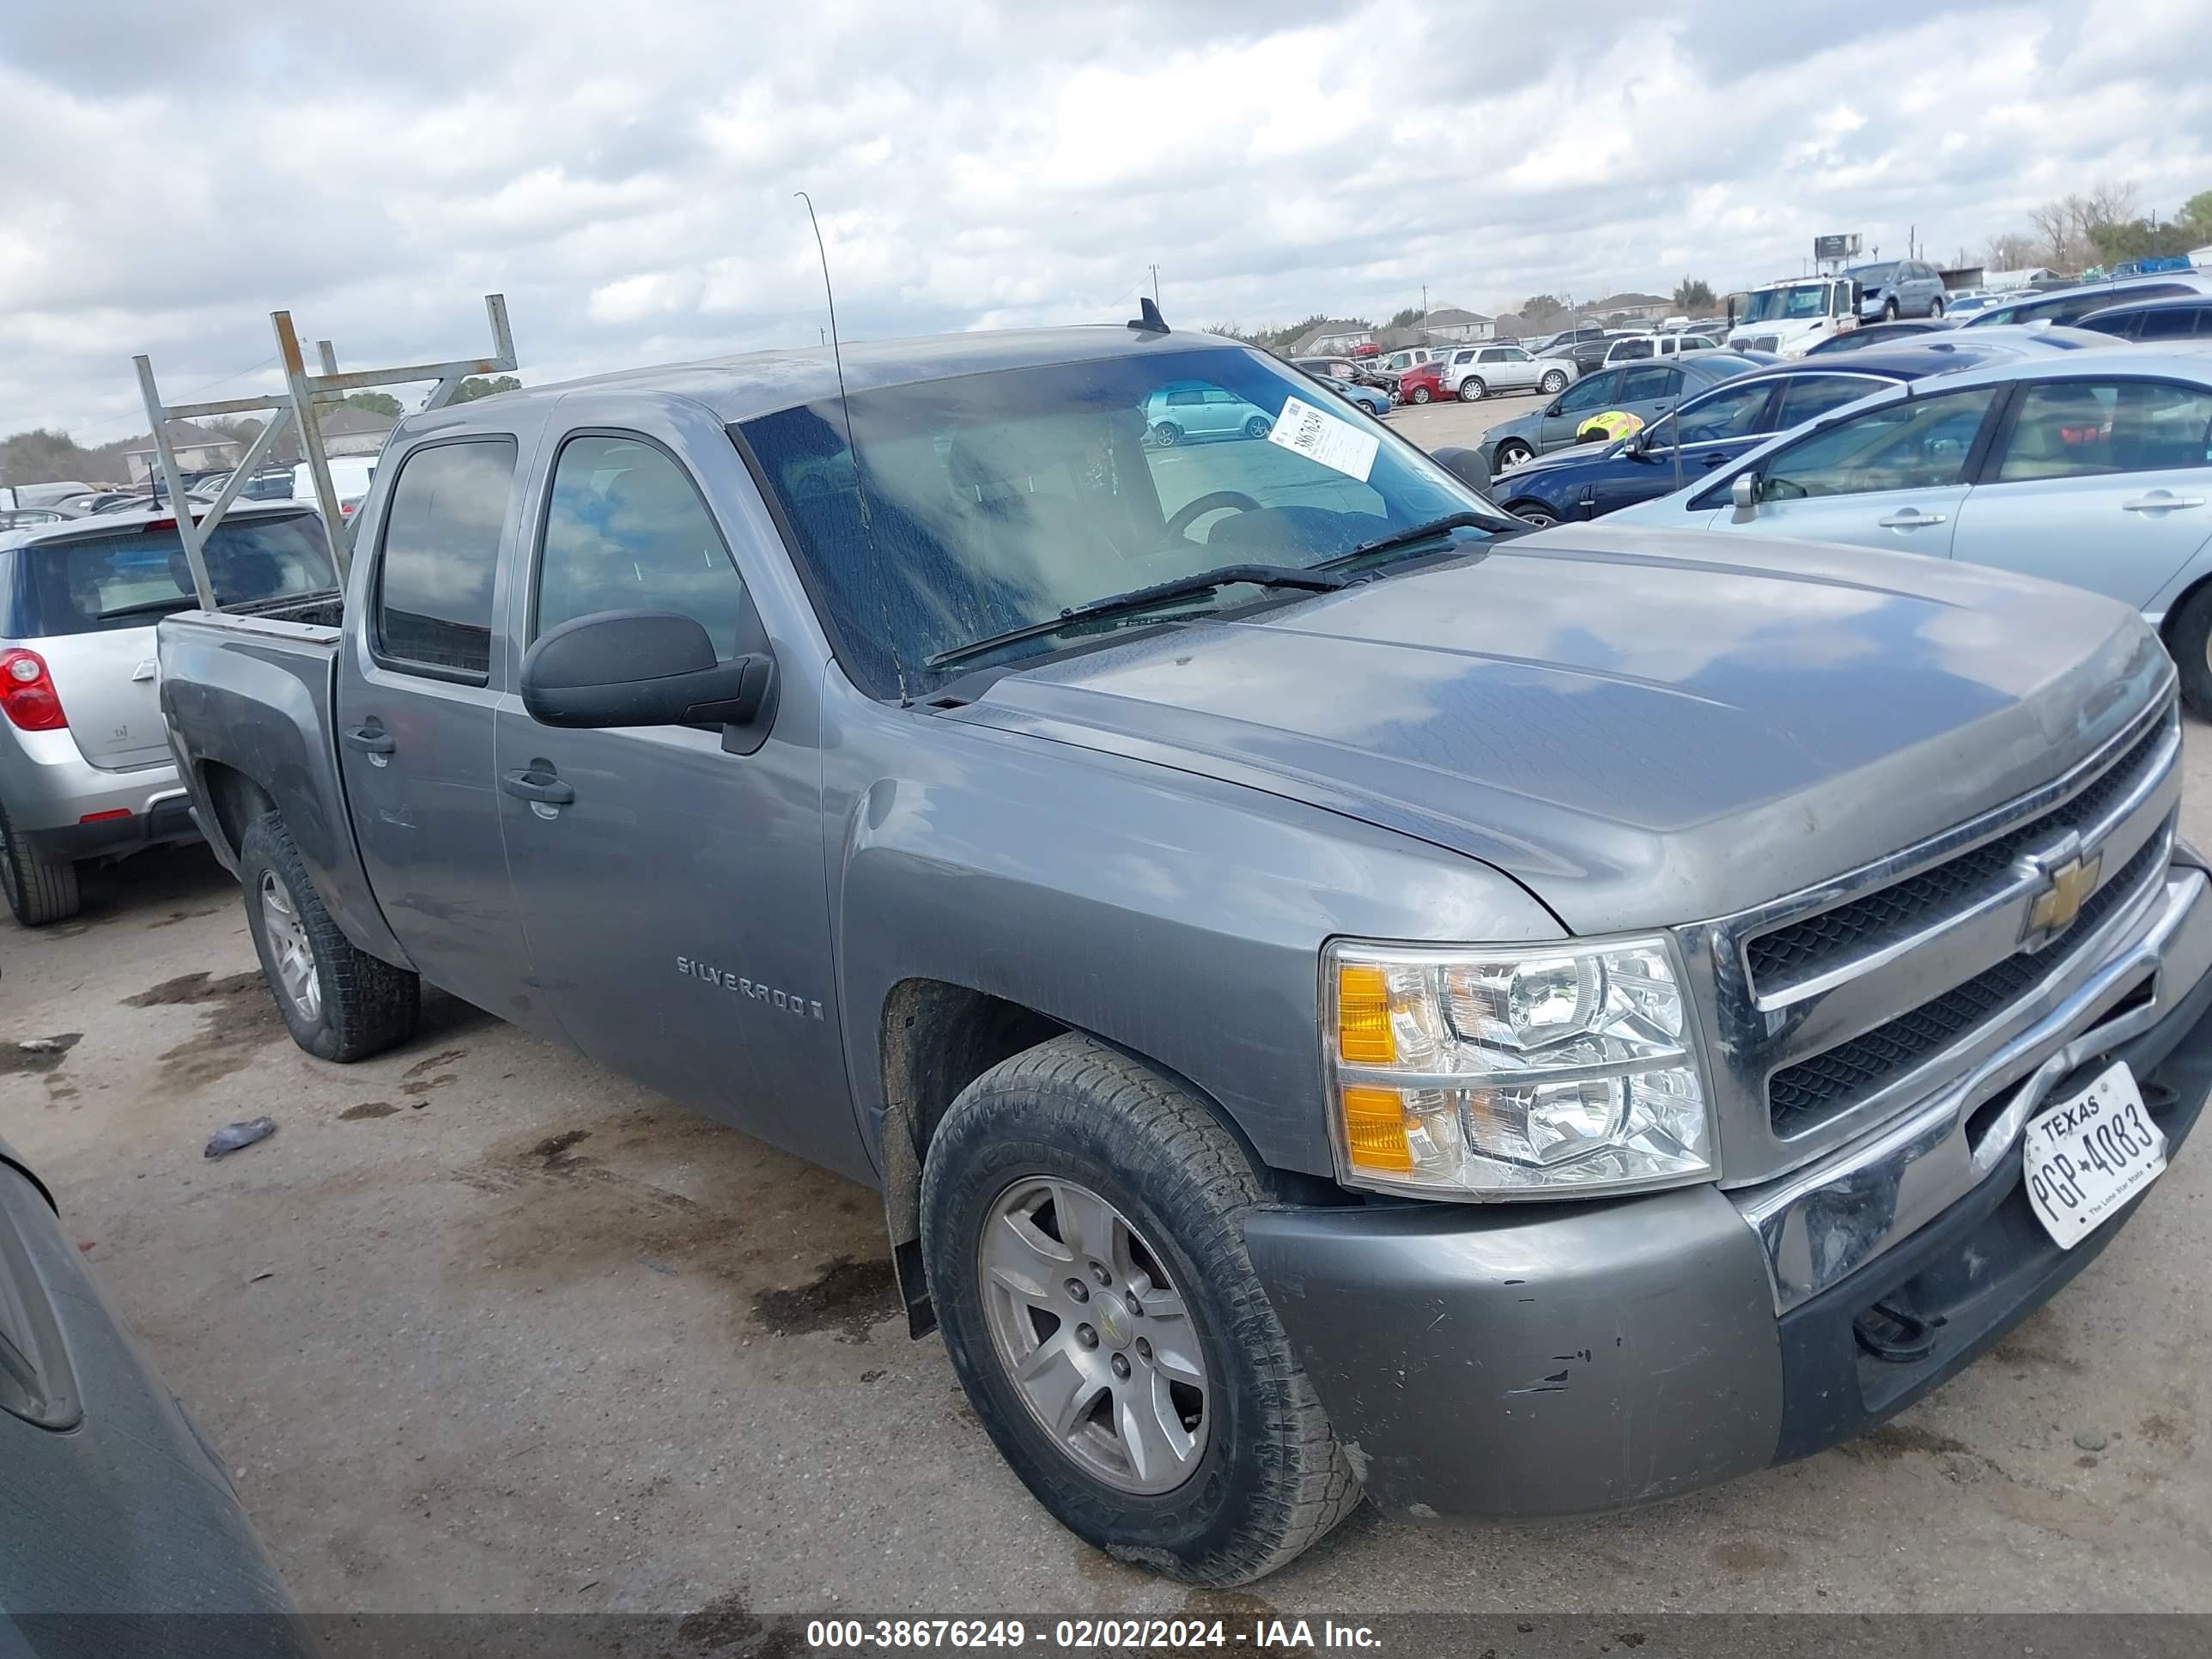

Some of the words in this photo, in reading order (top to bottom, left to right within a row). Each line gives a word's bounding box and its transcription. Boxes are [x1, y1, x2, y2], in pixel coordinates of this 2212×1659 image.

[1295, 411, 1324, 452] 38676249
[677, 956, 805, 1017] SILVERADO
[2041, 1095, 2100, 1142] TEXAS
[2089, 1205, 2103, 1216] The
[2100, 1192, 2117, 1206] Lone
[2115, 1182, 2129, 1194] Star
[2127, 1170, 2144, 1184] State
